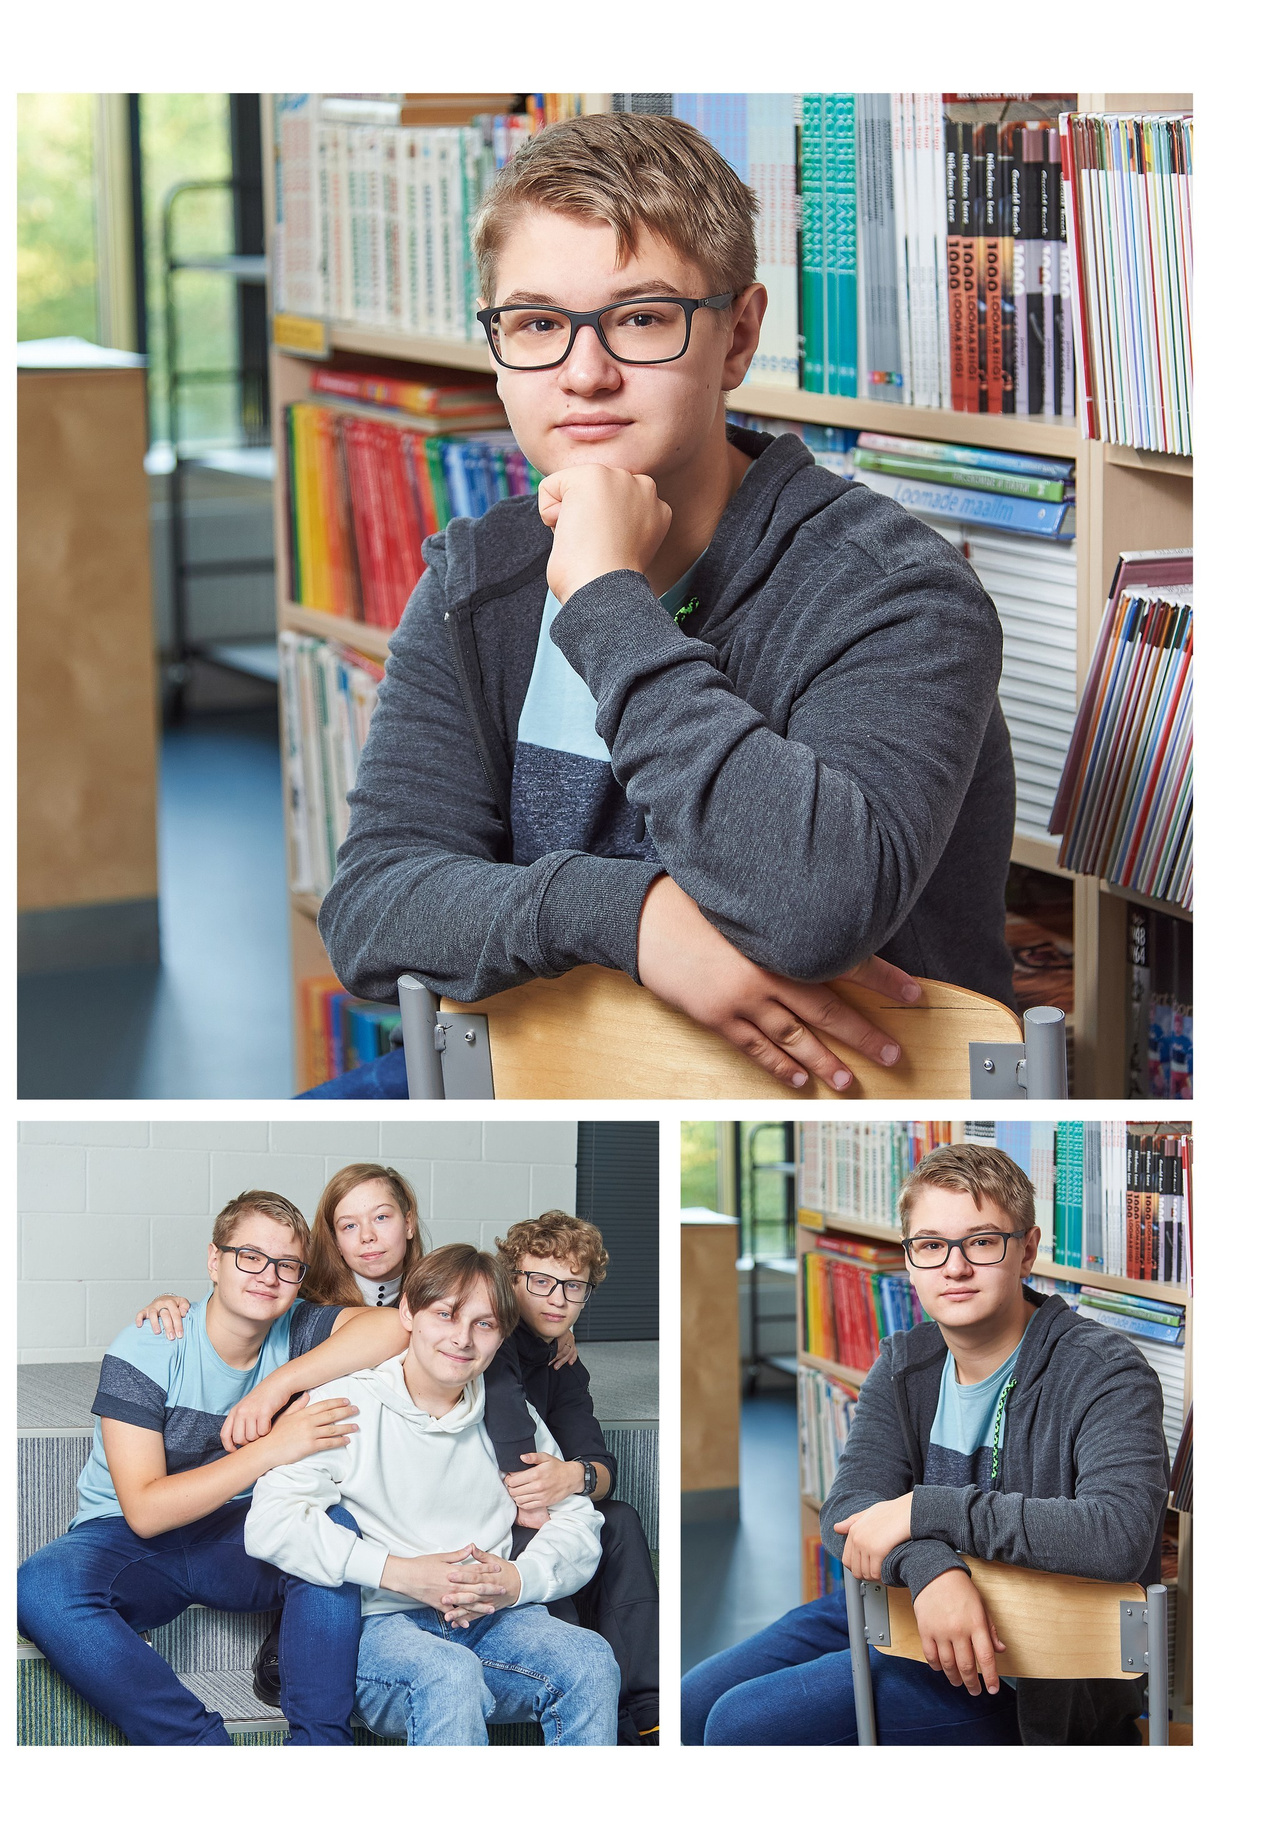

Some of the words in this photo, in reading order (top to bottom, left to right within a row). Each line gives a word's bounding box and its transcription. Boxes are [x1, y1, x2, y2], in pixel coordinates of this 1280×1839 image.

[948, 241, 960, 290] 1000
[963, 242, 974, 291] 1000
[986, 242, 998, 292] 1000
[893, 481, 959, 512] Loomade
[959, 495, 1015, 522] maailm
